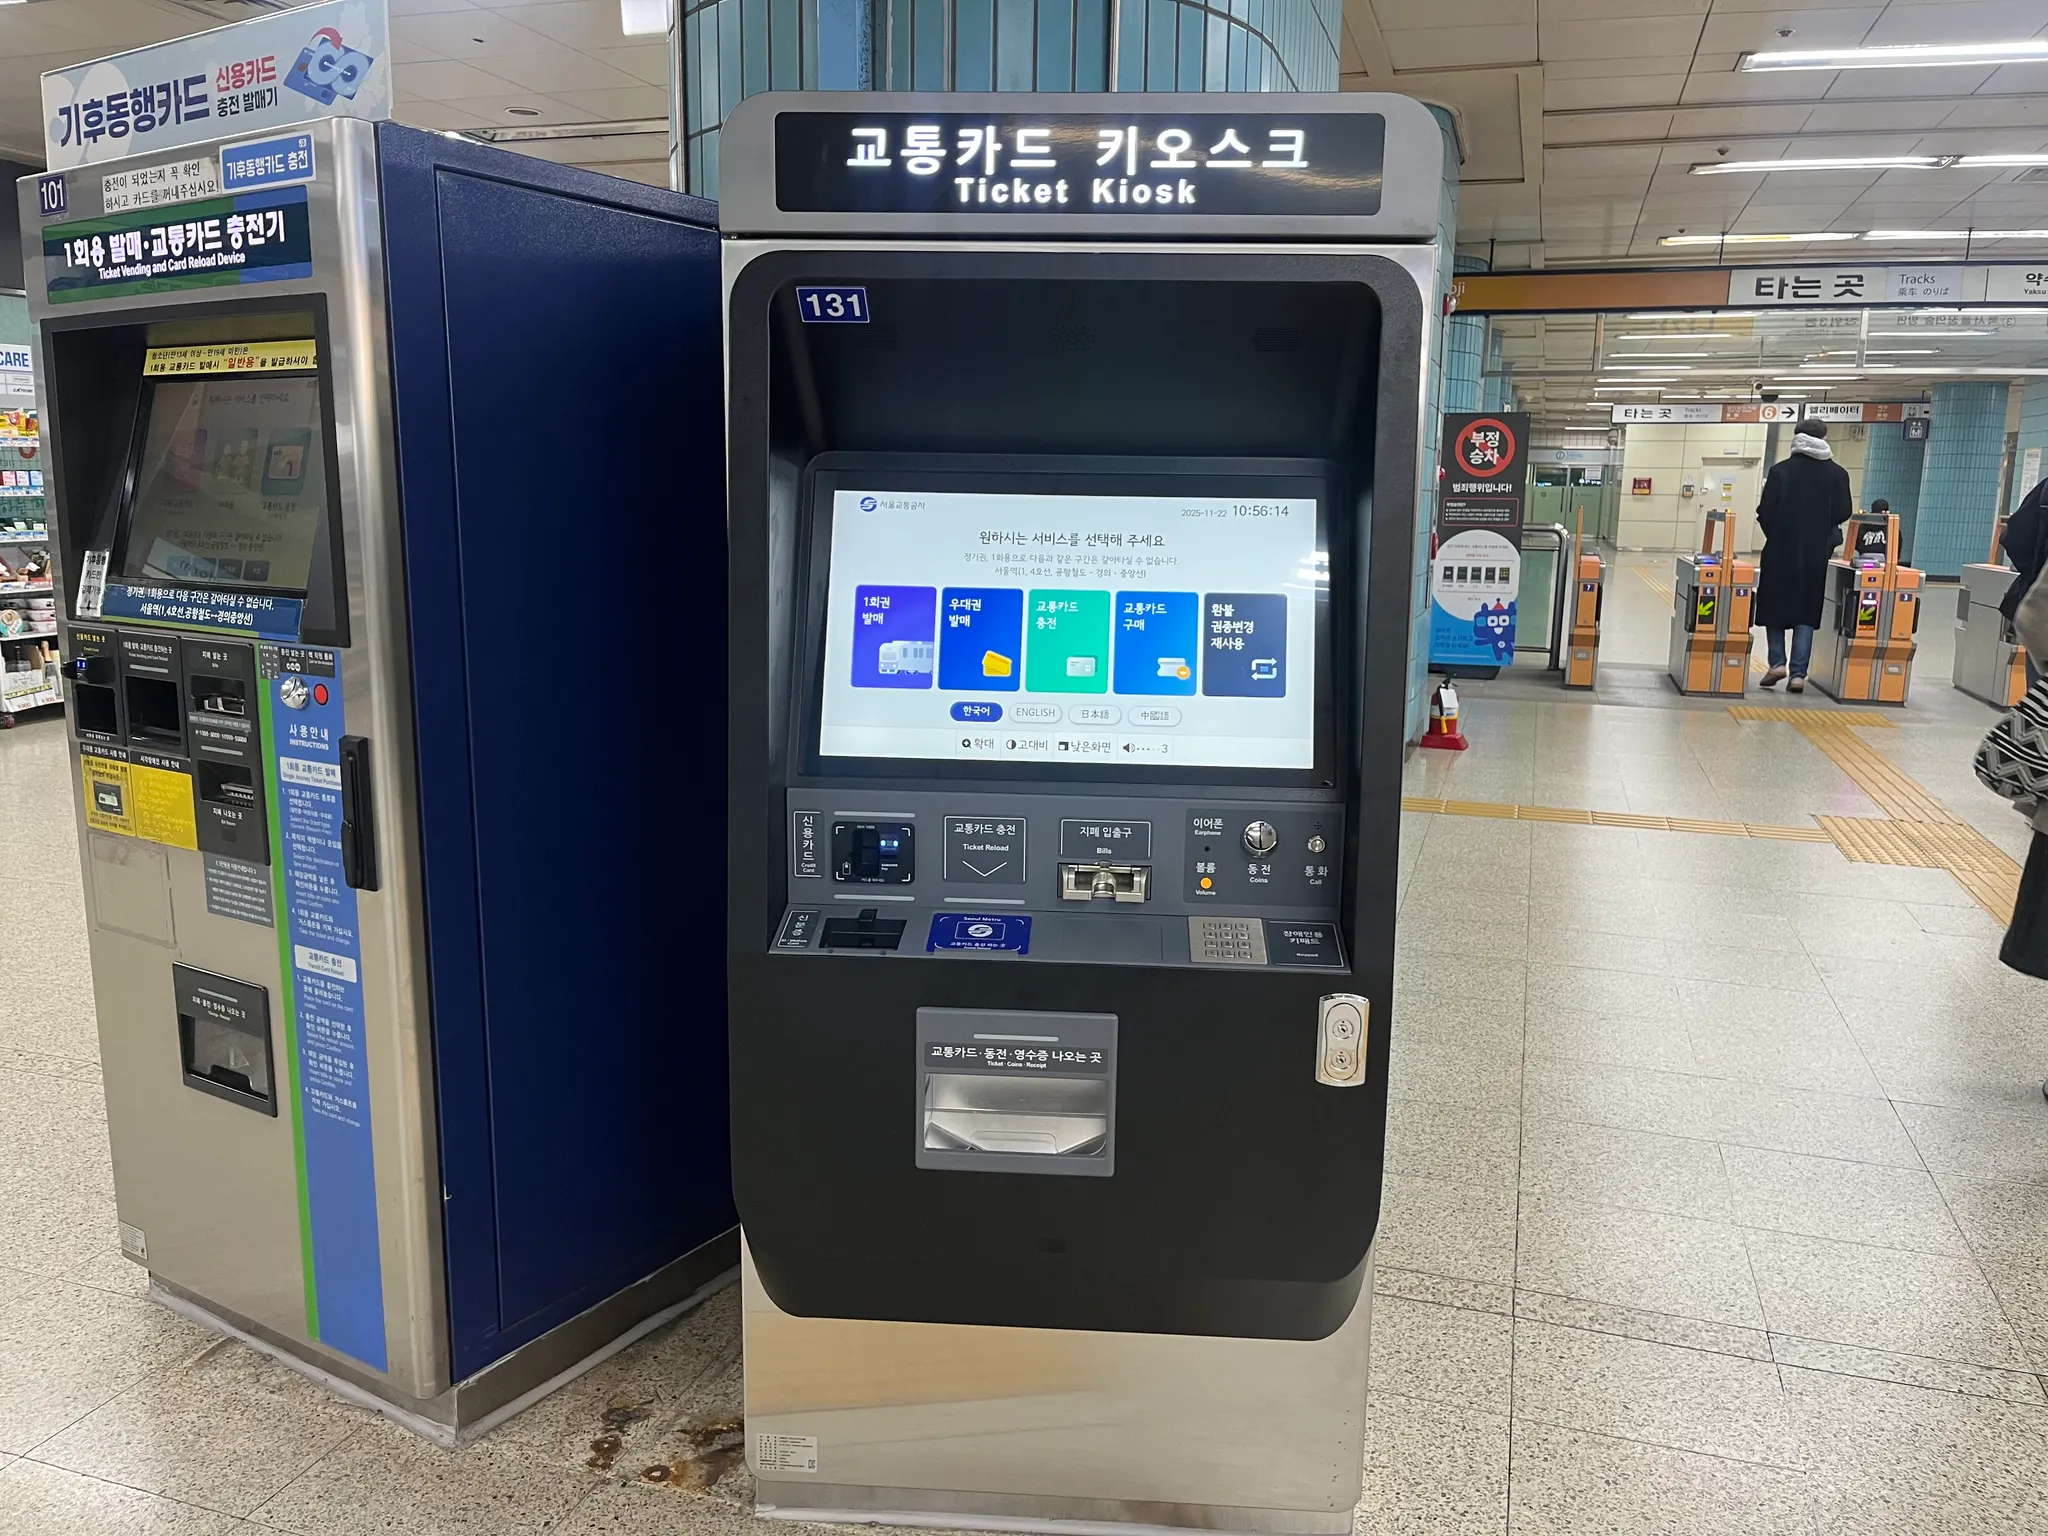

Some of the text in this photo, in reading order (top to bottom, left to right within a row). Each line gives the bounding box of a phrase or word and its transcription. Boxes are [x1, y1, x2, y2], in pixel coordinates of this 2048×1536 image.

[215, 55, 278, 94] 신용카드
[217, 86, 279, 118] 충전 발매기
[58, 74, 210, 148] 기후동행카드
[846, 124, 1309, 177] 교통카드 키오스크
[226, 149, 309, 180] 기후동행카드 충전
[104, 162, 200, 193] 충전이 되었는지 꼭 확인
[40, 179, 64, 210] 101
[954, 177, 1197, 205] Ticket Kiosk
[105, 194, 129, 210] 하시고
[133, 189, 159, 205] 카드를
[64, 236, 106, 268] 1회용
[226, 210, 286, 250] 충전기
[98, 251, 247, 280] Ticket Vending and Card Reload Device
[1899, 273, 1936, 284] Tracks
[1755, 274, 1866, 299] 타는 곳
[1922, 287, 1950, 296] のりば
[806, 293, 861, 317] 131
[169, 362, 196, 372] 교통카드
[1624, 408, 1672, 419] 타는 곳
[1809, 405, 1860, 415] 엘리베이터
[1470, 431, 1500, 448] 부정
[1469, 448, 1500, 465] 승차
[1452, 482, 1513, 494] 범죄행위입니다!
[879, 500, 926, 511] 서울교통공사
[1181, 504, 1290, 518] 2025-11-22 10:56:14
[979, 531, 1166, 548] 원하시는 서비스를 선택해 주세요
[963, 552, 1180, 567] 정기권, 1회용으로 다음과 같은 구간은 갈아타실 수 없습니다.
[1055, 568, 1087, 579] 공항철도
[1096, 569, 1111, 579] 경의
[1119, 569, 1147, 579] 중앙선)
[127, 586, 274, 611] 정기권, 1회용으로 다음 구간은 갈아타실 수 없습니다.
[863, 597, 891, 609] 1회권
[948, 598, 982, 611] 우대권
[1035, 601, 1079, 613] 교통카드
[1123, 603, 1167, 615] 교통카드
[1211, 604, 1235, 617] 환불
[862, 613, 885, 625] 발매
[948, 615, 971, 628] 발매
[1035, 617, 1057, 629] 충전
[1122, 619, 1145, 631] 구매
[1210, 620, 1254, 634] 권종변경
[1210, 637, 1245, 651] 재사용
[963, 706, 991, 717] 한국어
[1016, 707, 1056, 718] ENGLISH
[1082, 709, 1110, 720] 日本語
[1141, 711, 1170, 721] 中國語
[290, 738, 329, 751] INSTRUCTIONS
[974, 738, 994, 750] 확대
[1018, 740, 1048, 751] 고대비
[1070, 741, 1111, 754] 낮은화면
[1161, 744, 1169, 754] 3
[954, 823, 1016, 836] 교통카드 충전
[1193, 817, 1224, 830] 이어폰
[802, 815, 815, 861] 신용카드
[1079, 826, 1133, 839] 지폐 입출구
[1194, 829, 1223, 837] Earphone
[985, 844, 1010, 852] Reload
[1096, 847, 1113, 855] Bills
[1195, 861, 1217, 874] 볼륨
[1309, 878, 1322, 886] Call
[1283, 930, 1324, 938] 장애인용
[1289, 937, 1320, 945] 키패드
[931, 1046, 1102, 1063] 교통카드 동전 영수증 나오는 곳
